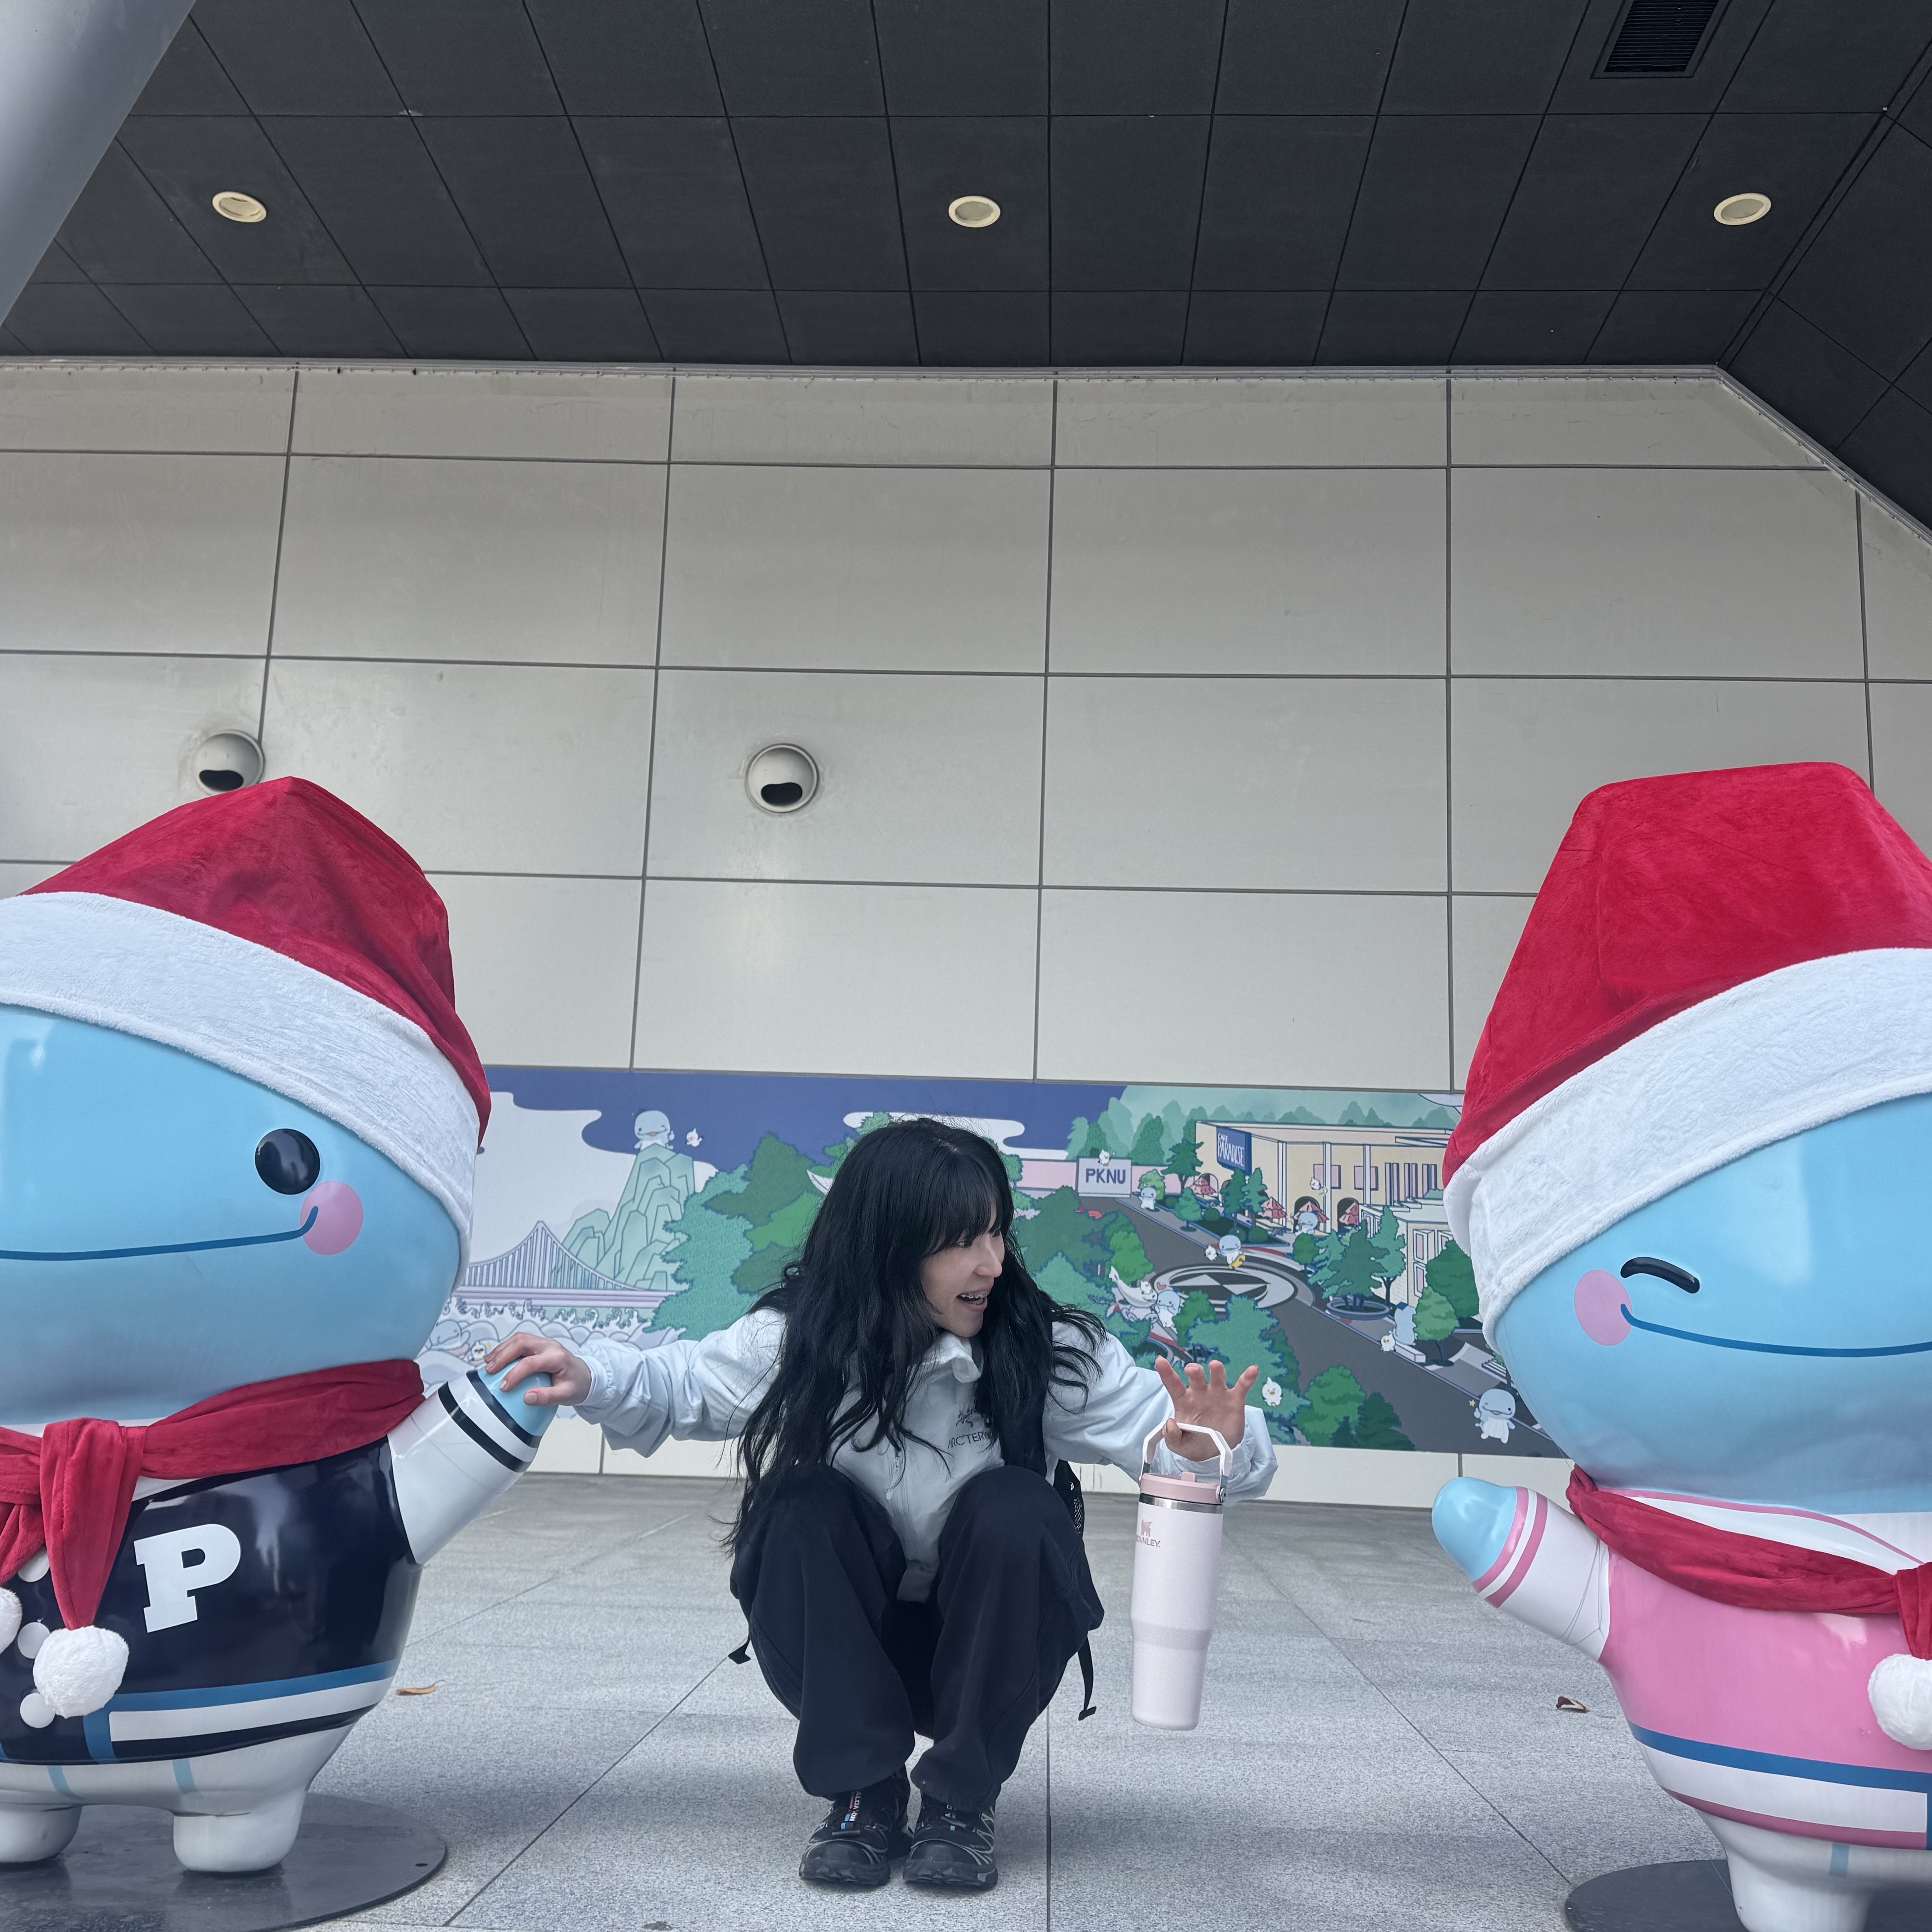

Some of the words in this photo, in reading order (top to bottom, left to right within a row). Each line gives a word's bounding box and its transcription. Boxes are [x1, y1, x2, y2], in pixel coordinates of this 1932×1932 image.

[1218, 1140, 1245, 1167] PARADISE
[1086, 1168, 1126, 1184] PKNU
[134, 1524, 241, 1633] P
